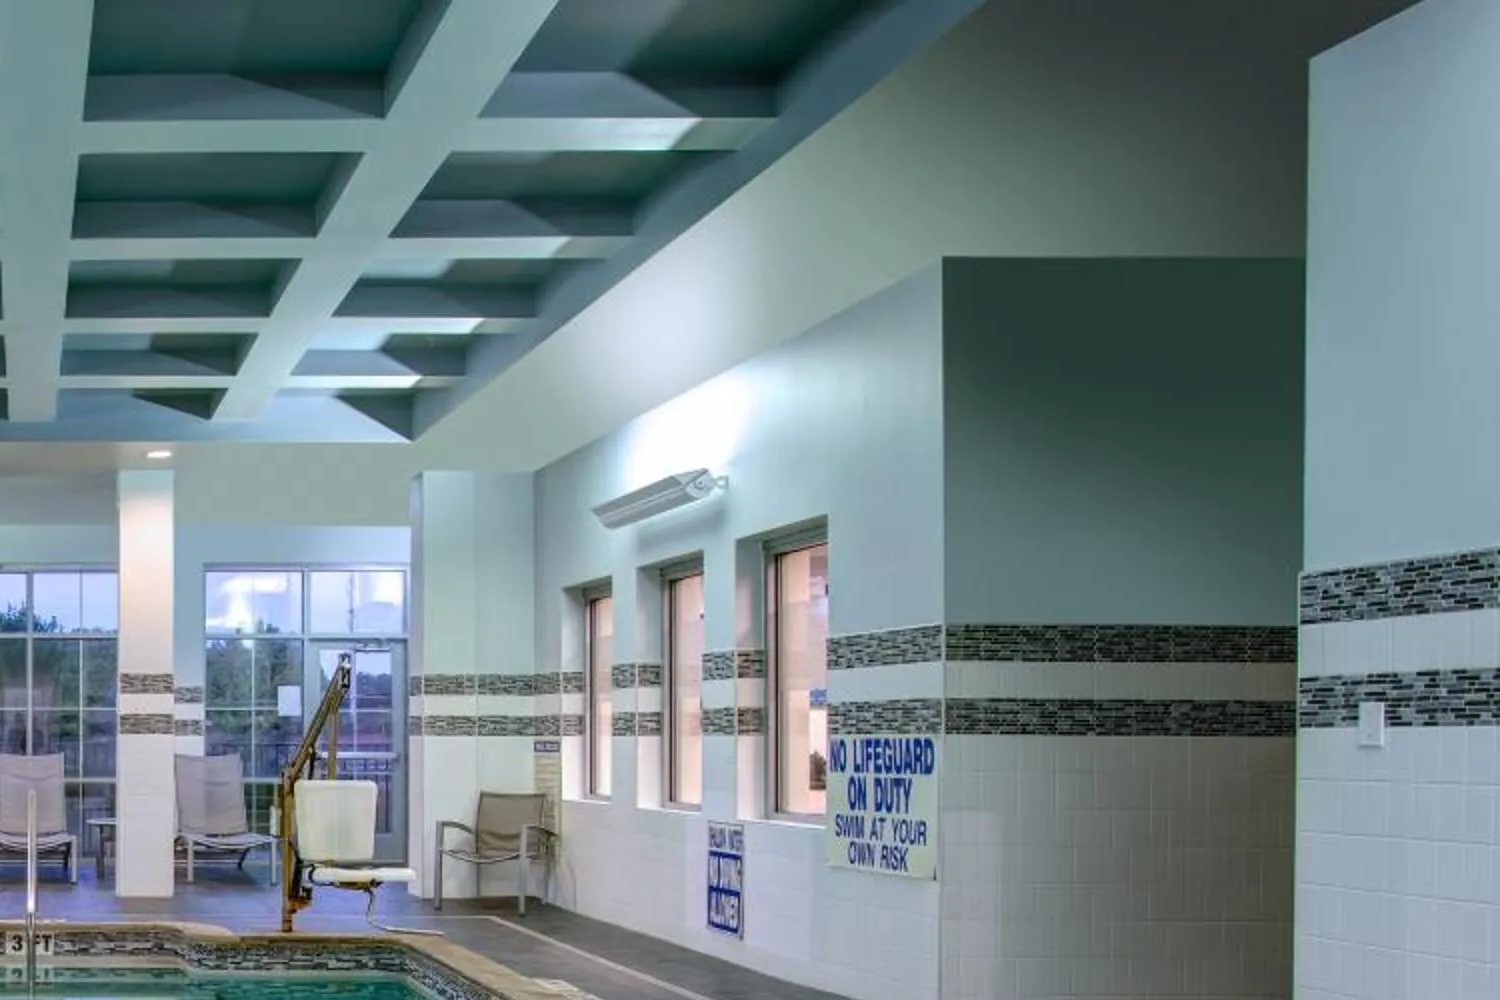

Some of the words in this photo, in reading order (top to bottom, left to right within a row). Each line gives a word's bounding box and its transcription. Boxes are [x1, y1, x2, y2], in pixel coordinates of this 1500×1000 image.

[830, 738, 847, 773] NO
[853, 738, 935, 775] LIFEGUARD
[847, 776, 867, 811] ON
[874, 777, 913, 814] DUTY
[835, 813, 865, 839] SWIM
[869, 817, 887, 842] AT
[891, 819, 927, 846] YOUR
[847, 841, 875, 867] OWN
[880, 845, 909, 872] RISK
[11, 934, 23, 952] 3
